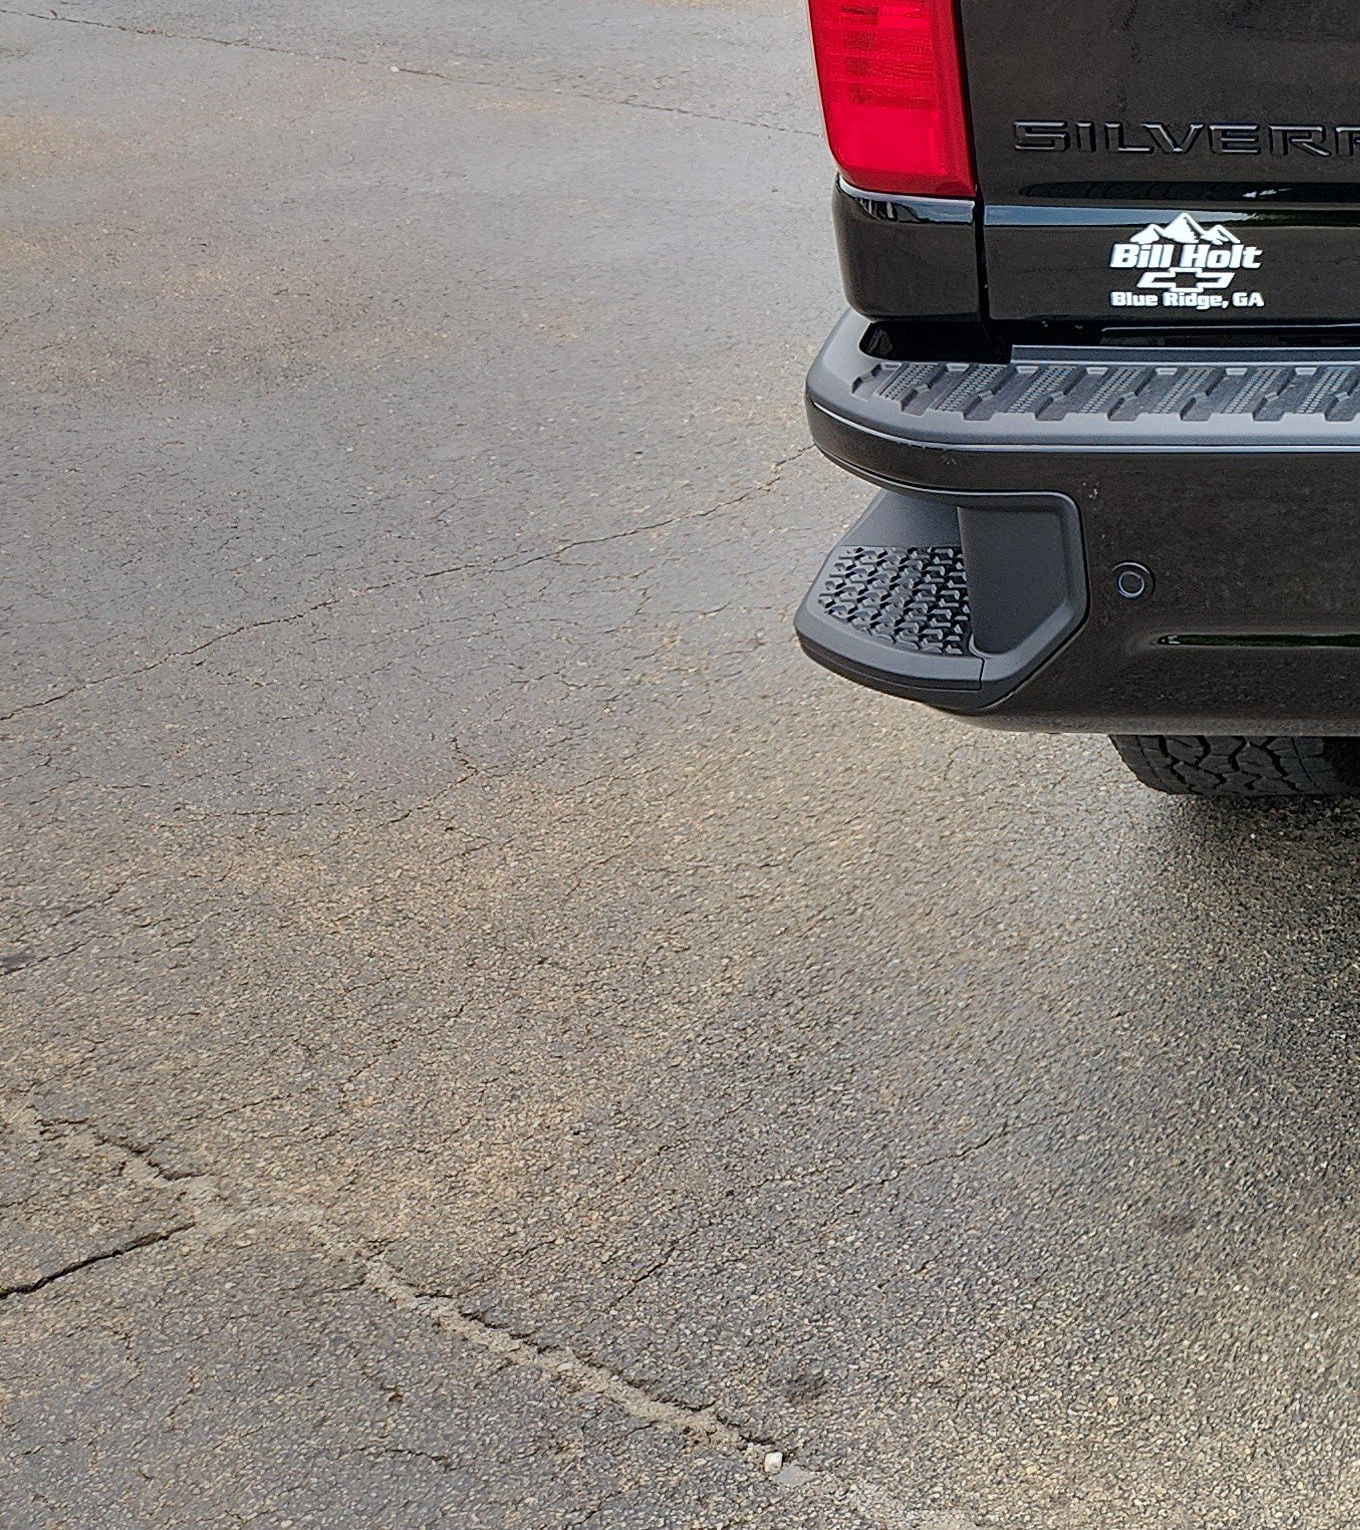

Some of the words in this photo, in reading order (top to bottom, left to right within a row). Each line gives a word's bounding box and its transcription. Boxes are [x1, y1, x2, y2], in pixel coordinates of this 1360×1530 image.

[1110, 243, 1175, 268] Bill
[1179, 244, 1263, 269] Holt
[1110, 291, 1158, 307] Blue
[1162, 291, 1229, 310] Ridge,
[1232, 292, 1265, 307] GA
